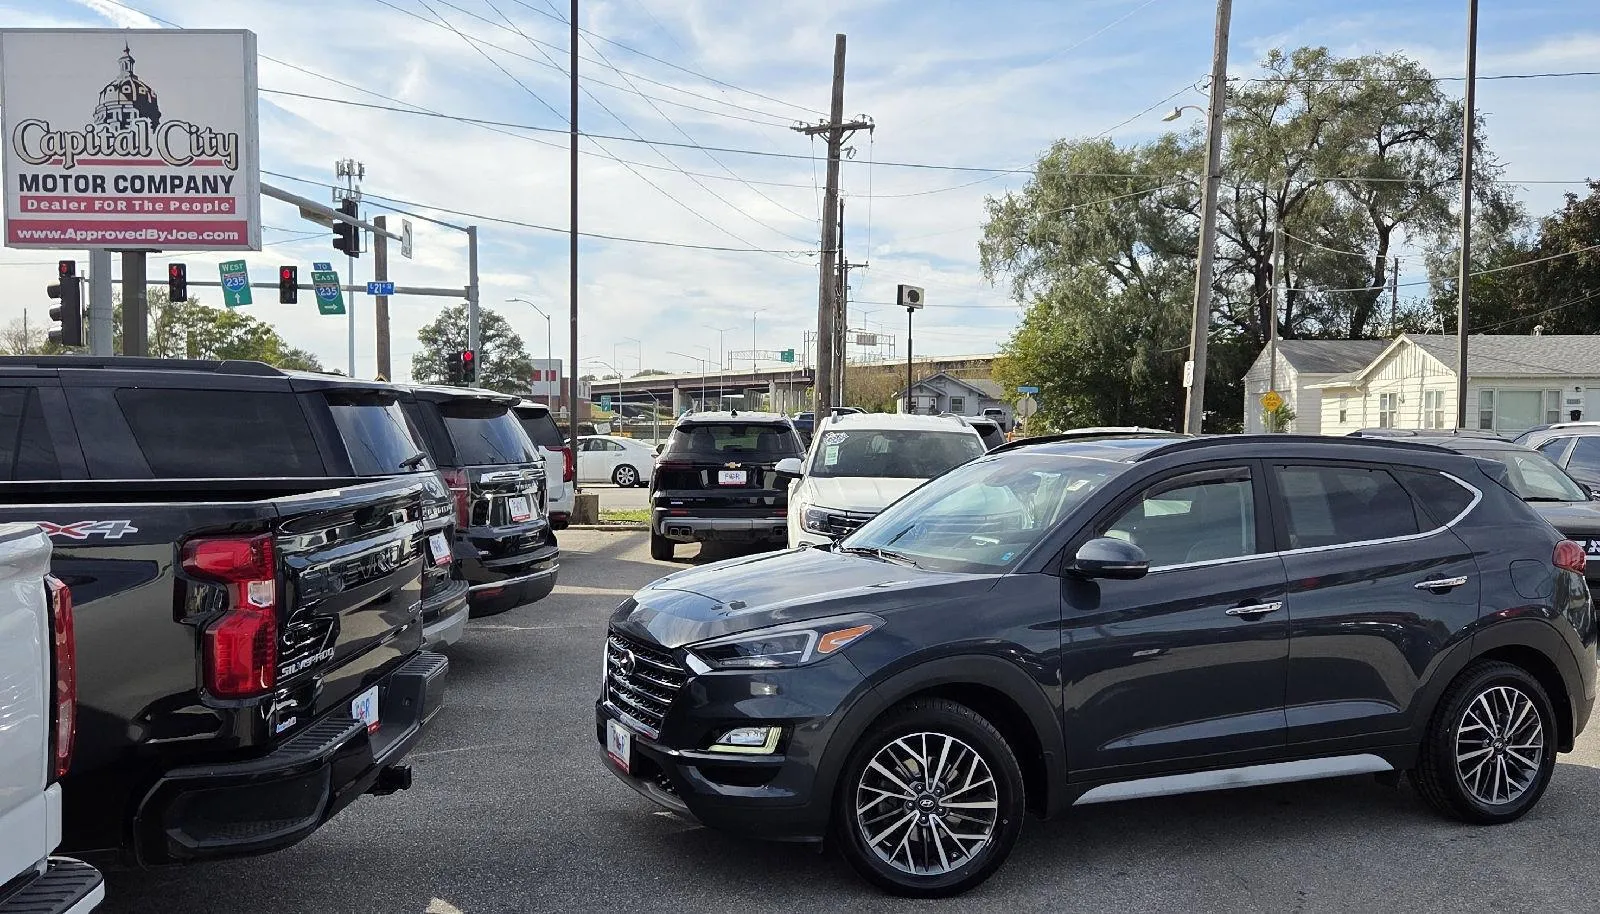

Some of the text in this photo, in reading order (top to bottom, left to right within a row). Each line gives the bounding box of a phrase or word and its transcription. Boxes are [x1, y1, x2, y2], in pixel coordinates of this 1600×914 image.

[13, 118, 239, 171] Capital City
[19, 174, 235, 194] MOTOR COMPANY
[27, 199, 231, 213] Dealer FOR The People
[17, 227, 239, 242] www.ApprovedByJoe.com
[221, 263, 244, 271] WEST
[226, 277, 245, 287] 235
[320, 287, 339, 296] 235
